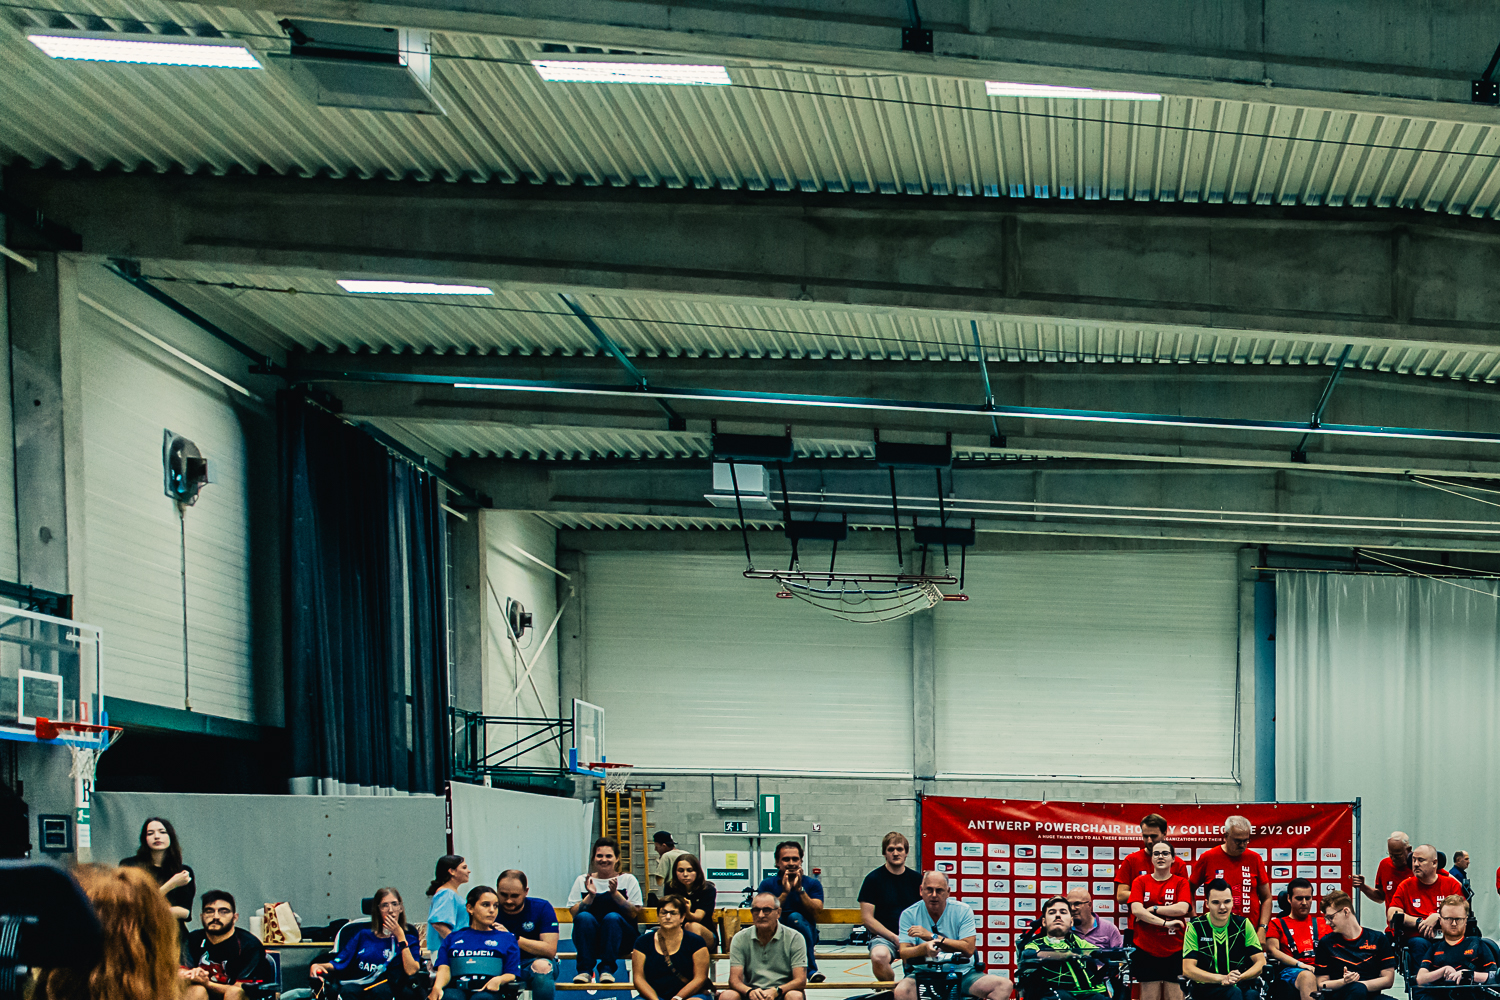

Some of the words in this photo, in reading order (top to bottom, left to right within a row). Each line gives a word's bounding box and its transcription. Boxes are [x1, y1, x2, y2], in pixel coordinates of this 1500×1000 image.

[967, 820, 1031, 831] ANTWERP
[1035, 822, 1121, 834] POWERCHAIR
[1125, 825, 1176, 835] HOY
[1260, 825, 1283, 835] 2V2
[1286, 825, 1311, 835] CUP
[1241, 865, 1252, 913] REFEREE
[452, 949, 495, 957] CARMEN
